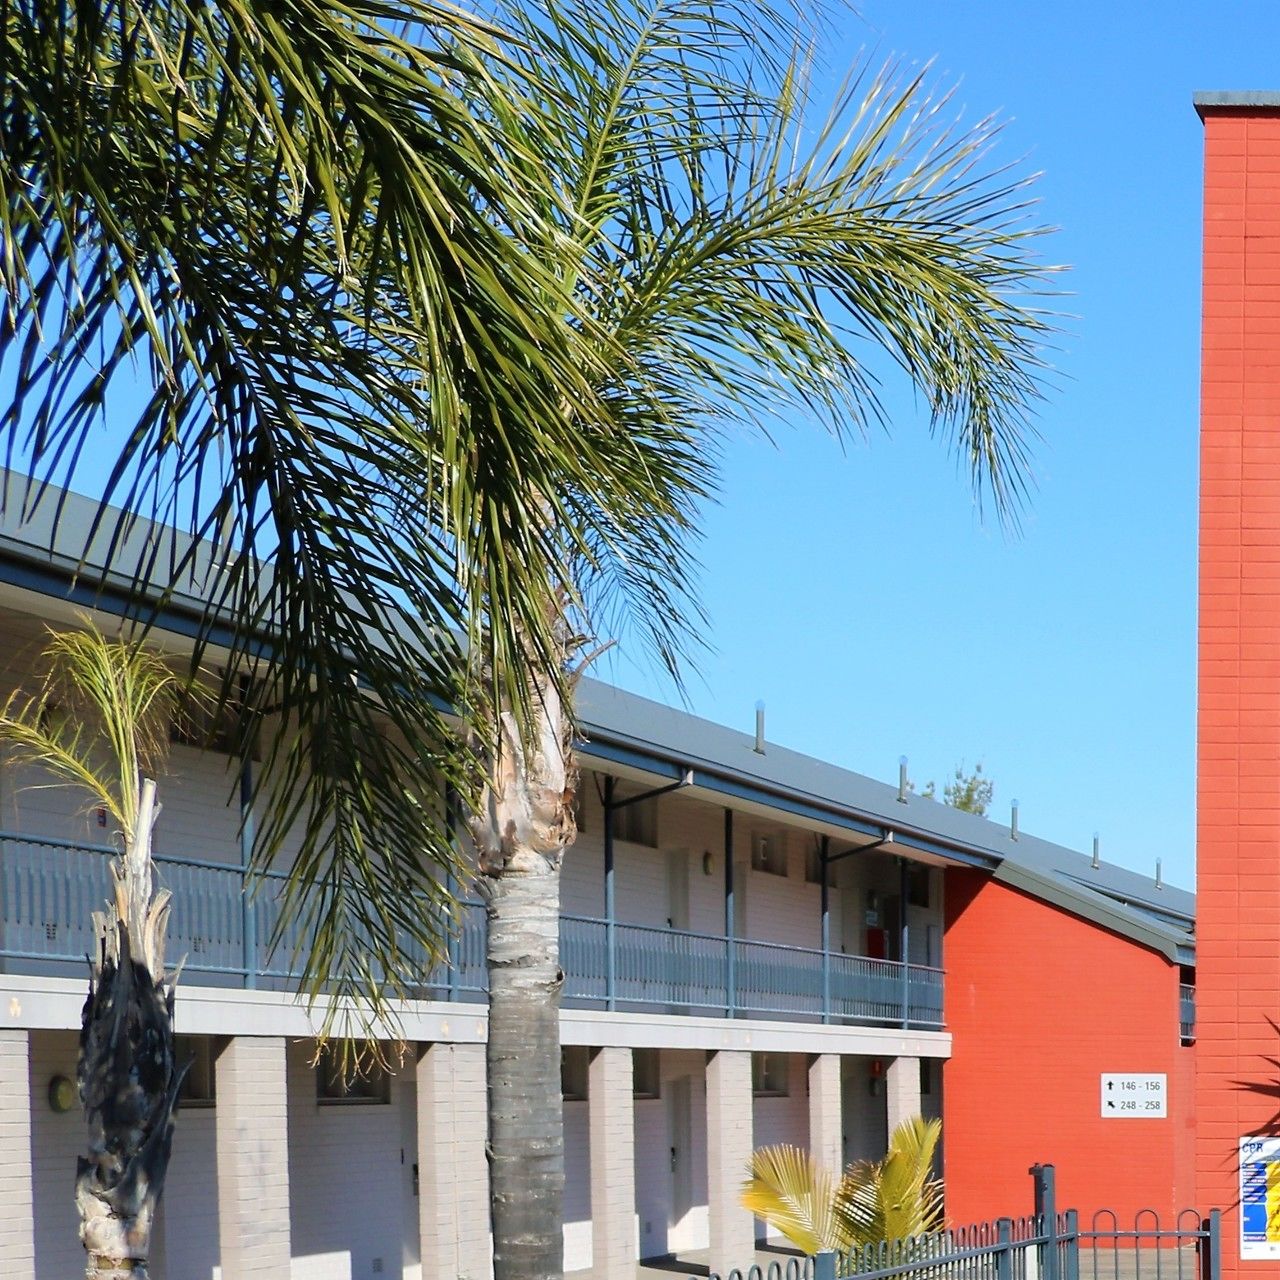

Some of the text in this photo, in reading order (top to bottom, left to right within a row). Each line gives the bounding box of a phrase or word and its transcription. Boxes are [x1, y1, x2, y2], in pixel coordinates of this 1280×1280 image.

[1120, 1081, 1136, 1091] 146
[1145, 1081, 1161, 1091] 156
[1120, 1100, 1136, 1110] 248
[1145, 1100, 1161, 1110] 258
[1242, 1142, 1264, 1153] CPR
